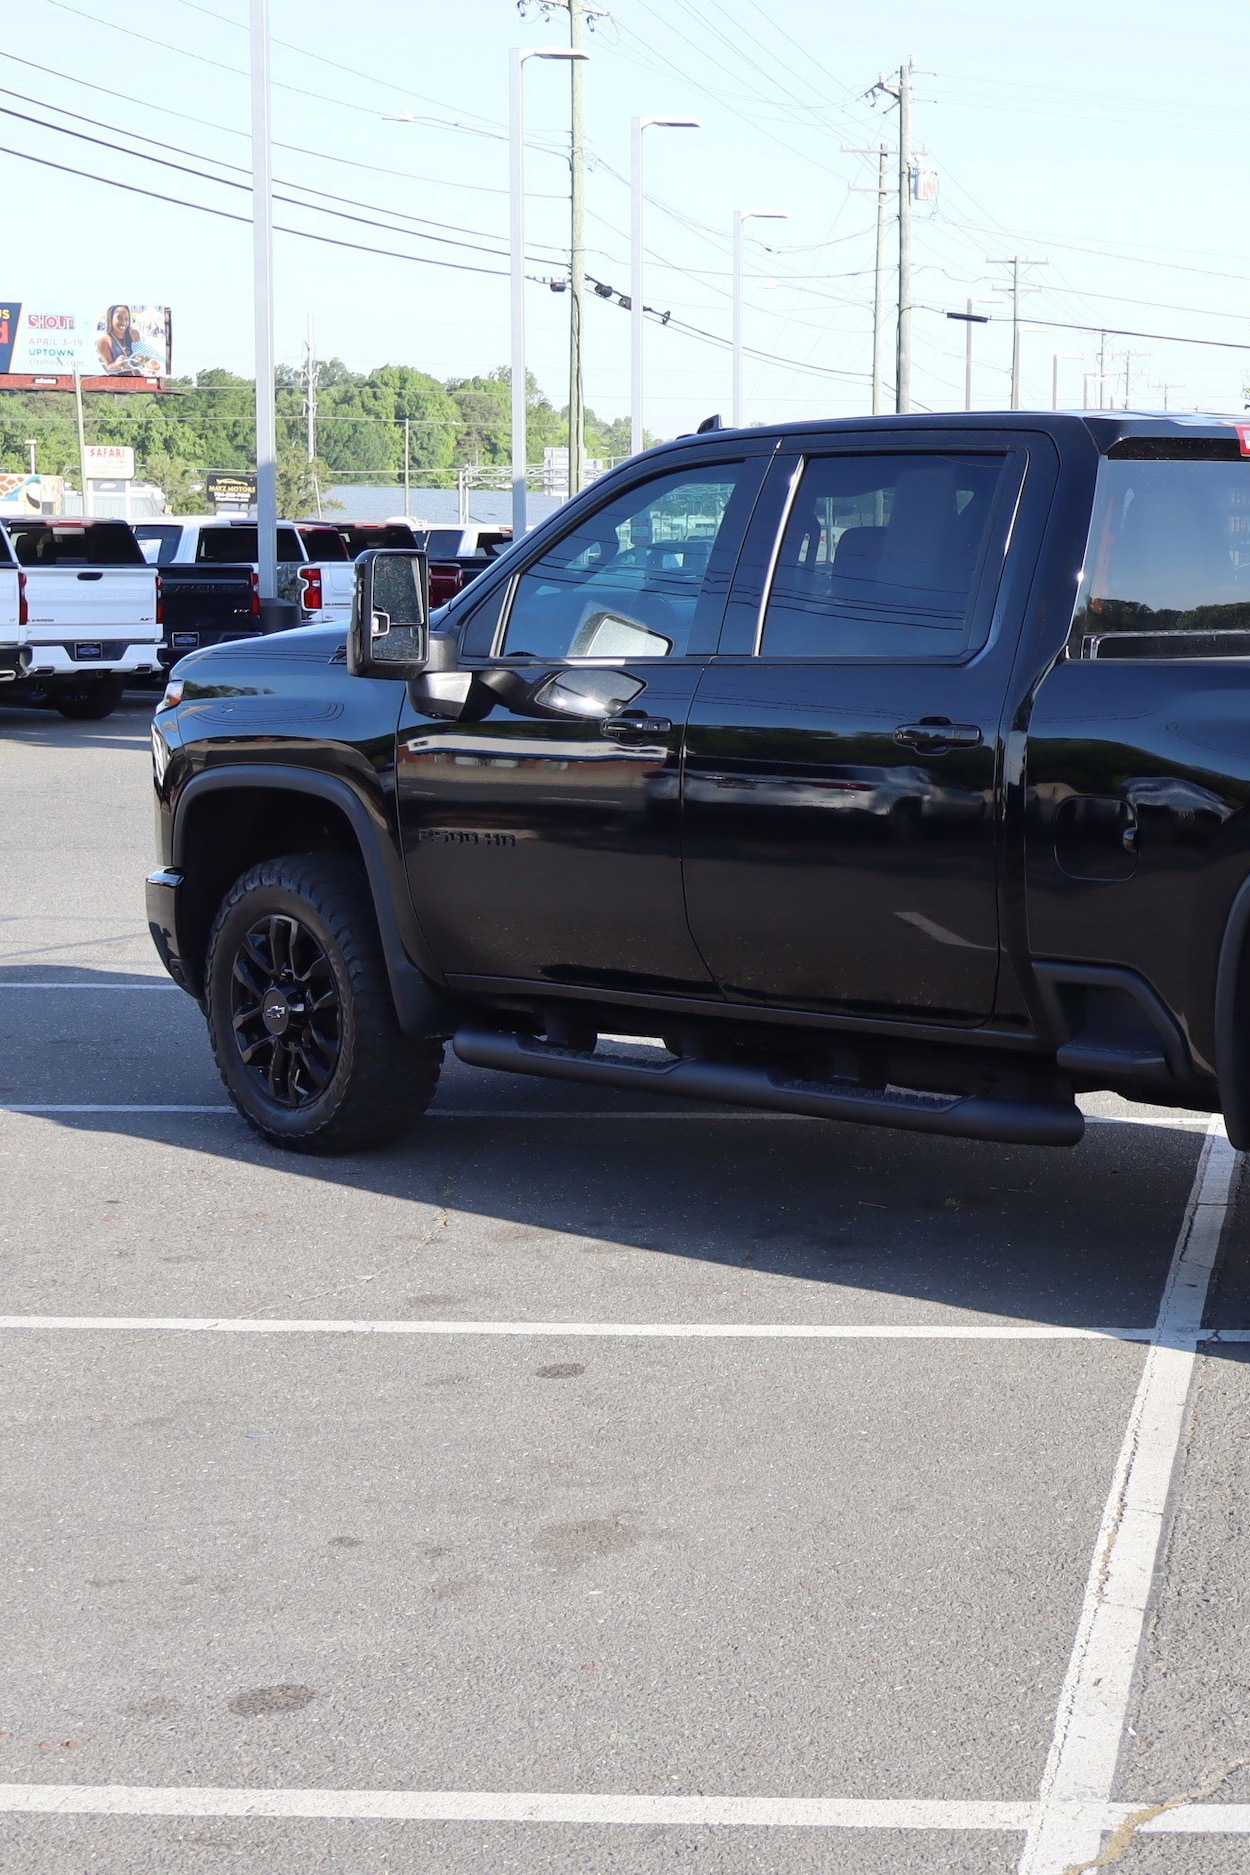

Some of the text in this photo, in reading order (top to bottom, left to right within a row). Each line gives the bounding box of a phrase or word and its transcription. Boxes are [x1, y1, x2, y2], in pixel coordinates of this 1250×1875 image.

[29, 338, 83, 347] APRIL 3-19
[29, 349, 74, 357] UPTOWN
[90, 448, 125, 458] SAFARI
[418, 828, 516, 848] 2500 HD
